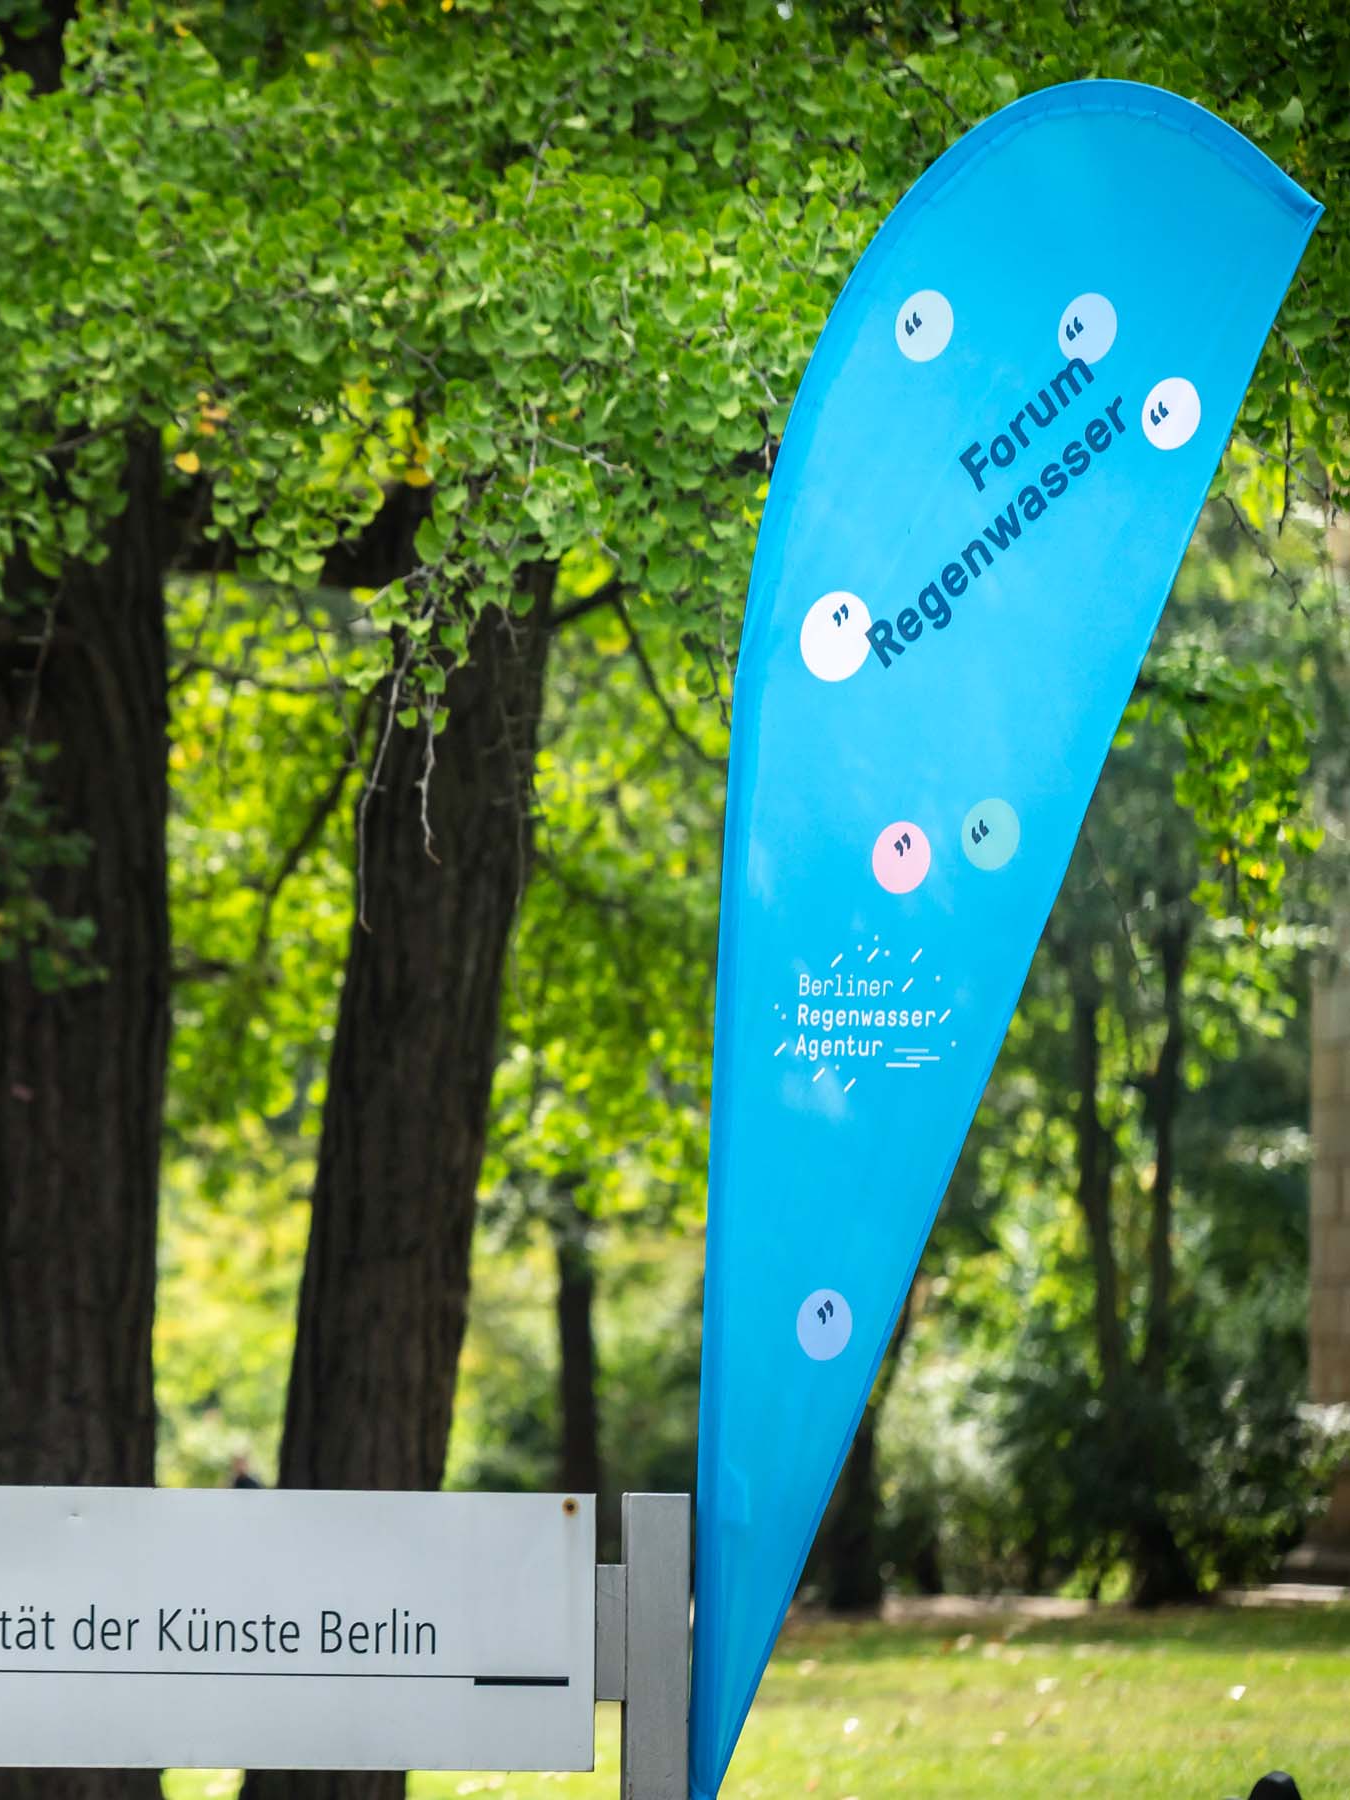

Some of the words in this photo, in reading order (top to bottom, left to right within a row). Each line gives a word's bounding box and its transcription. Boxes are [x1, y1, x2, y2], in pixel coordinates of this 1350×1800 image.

[958, 357, 1095, 493] Forum
[864, 394, 1127, 669] Regenwasser
[798, 973, 894, 997] Berliner
[796, 1003, 936, 1032] Regenwasser
[794, 1033, 883, 1062] Agentur
[72, 1603, 141, 1651] der
[157, 1607, 301, 1654] Künste
[319, 1607, 438, 1655] Berlin
